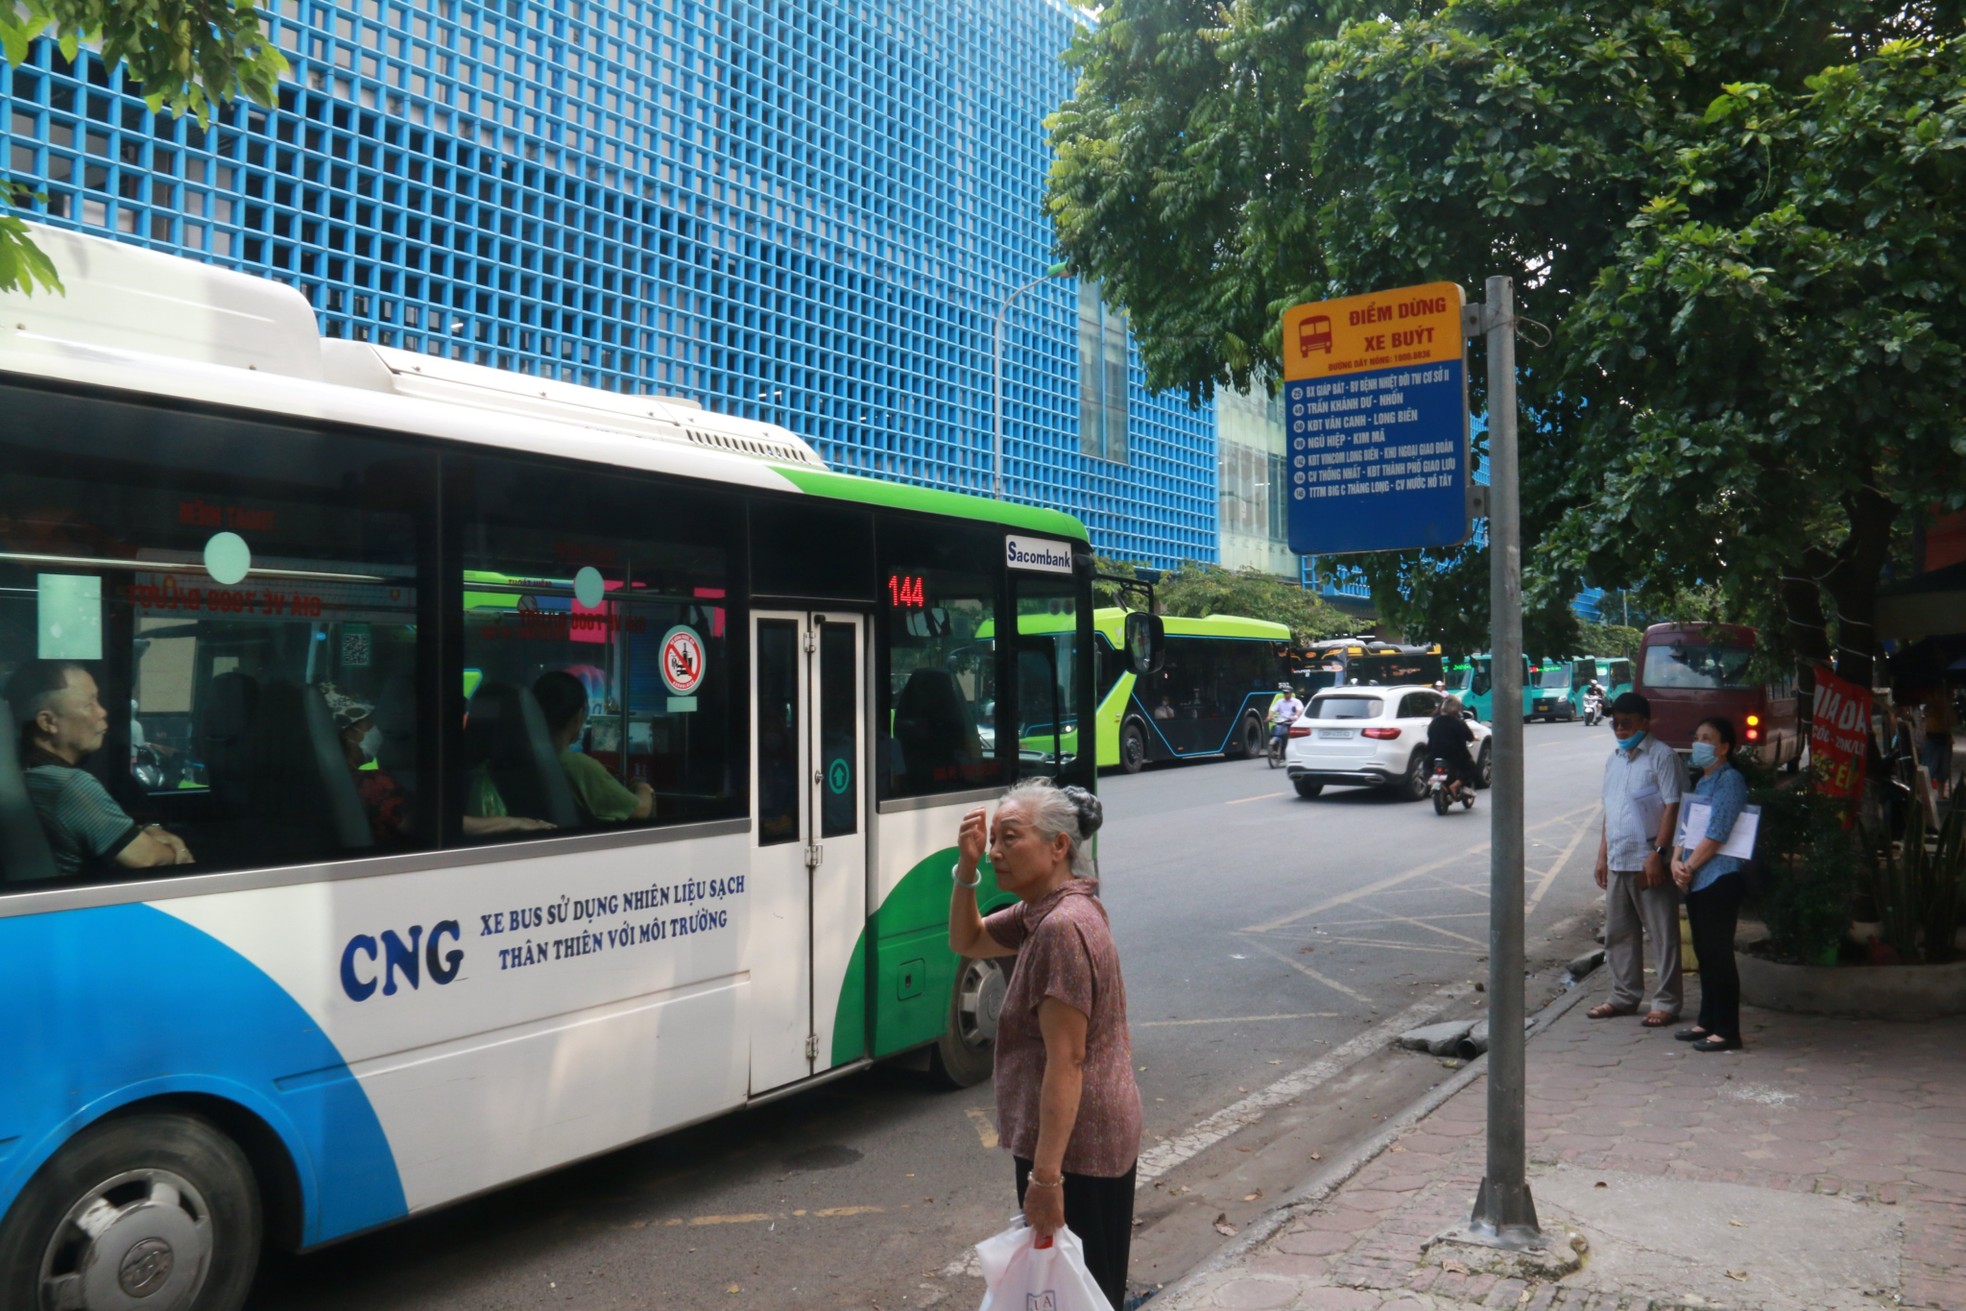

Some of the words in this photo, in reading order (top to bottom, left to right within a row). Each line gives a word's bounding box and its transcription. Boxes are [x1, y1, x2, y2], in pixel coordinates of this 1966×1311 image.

[1349, 302, 1392, 326] ĐIỂM
[1399, 297, 1446, 319] DỪNG
[1364, 335, 1386, 352] XE
[1392, 326, 1434, 348] BUÝT
[1306, 386, 1315, 398] BX
[1316, 382, 1331, 397] GIÁP
[1350, 380, 1359, 393] BV
[1360, 376, 1377, 394] BỆNH
[1379, 373, 1397, 390] NHIỆT
[1411, 372, 1422, 385] TW
[1423, 370, 1432, 383] CƠ
[1330, 396, 1358, 412] KHÁNH
[1360, 396, 1372, 408] DƯ
[1307, 419, 1322, 432] KĐT
[1344, 414, 1366, 428] CANH
[1374, 412, 1396, 425] LONG
[1398, 407, 1418, 422] BIÊN
[1327, 432, 1345, 449] HIỆP
[1353, 432, 1369, 444] KIM
[1346, 451, 1362, 462] LONG
[1364, 447, 1379, 460] BIÊN
[1384, 446, 1397, 459] KHU
[1419, 444, 1435, 455] GIAO
[1308, 471, 1317, 483] CV
[1319, 465, 1341, 482] THỐNG
[1343, 464, 1361, 480] NHẤT
[1382, 460, 1405, 476] THÀNH
[1407, 458, 1422, 473] PHỐ
[1423, 460, 1440, 472] GIAO
[1441, 458, 1456, 471] LƯU
[1309, 486, 1326, 498] TTTM
[1328, 485, 1339, 496] BIG
[1341, 485, 1346, 496] C
[1395, 480, 1405, 491] CV
[1406, 475, 1426, 490] NƯỚC
[1439, 473, 1452, 487] TÂY
[1008, 541, 1071, 568] Sacombank
[888, 575, 924, 607] 144
[480, 914, 505, 936] XE
[510, 906, 543, 931] BUS
[546, 894, 570, 924] SỬ
[574, 895, 618, 923] DỤNG
[623, 883, 670, 912] NHIÊN
[673, 876, 706, 906] LIỆU
[709, 875, 745, 902] SẠCH
[498, 939, 548, 970] THÂN
[608, 920, 635, 949] VỚI
[639, 917, 666, 944] MÔI
[670, 909, 728, 937] TRƯỜNG
[340, 920, 465, 1003] CNG
